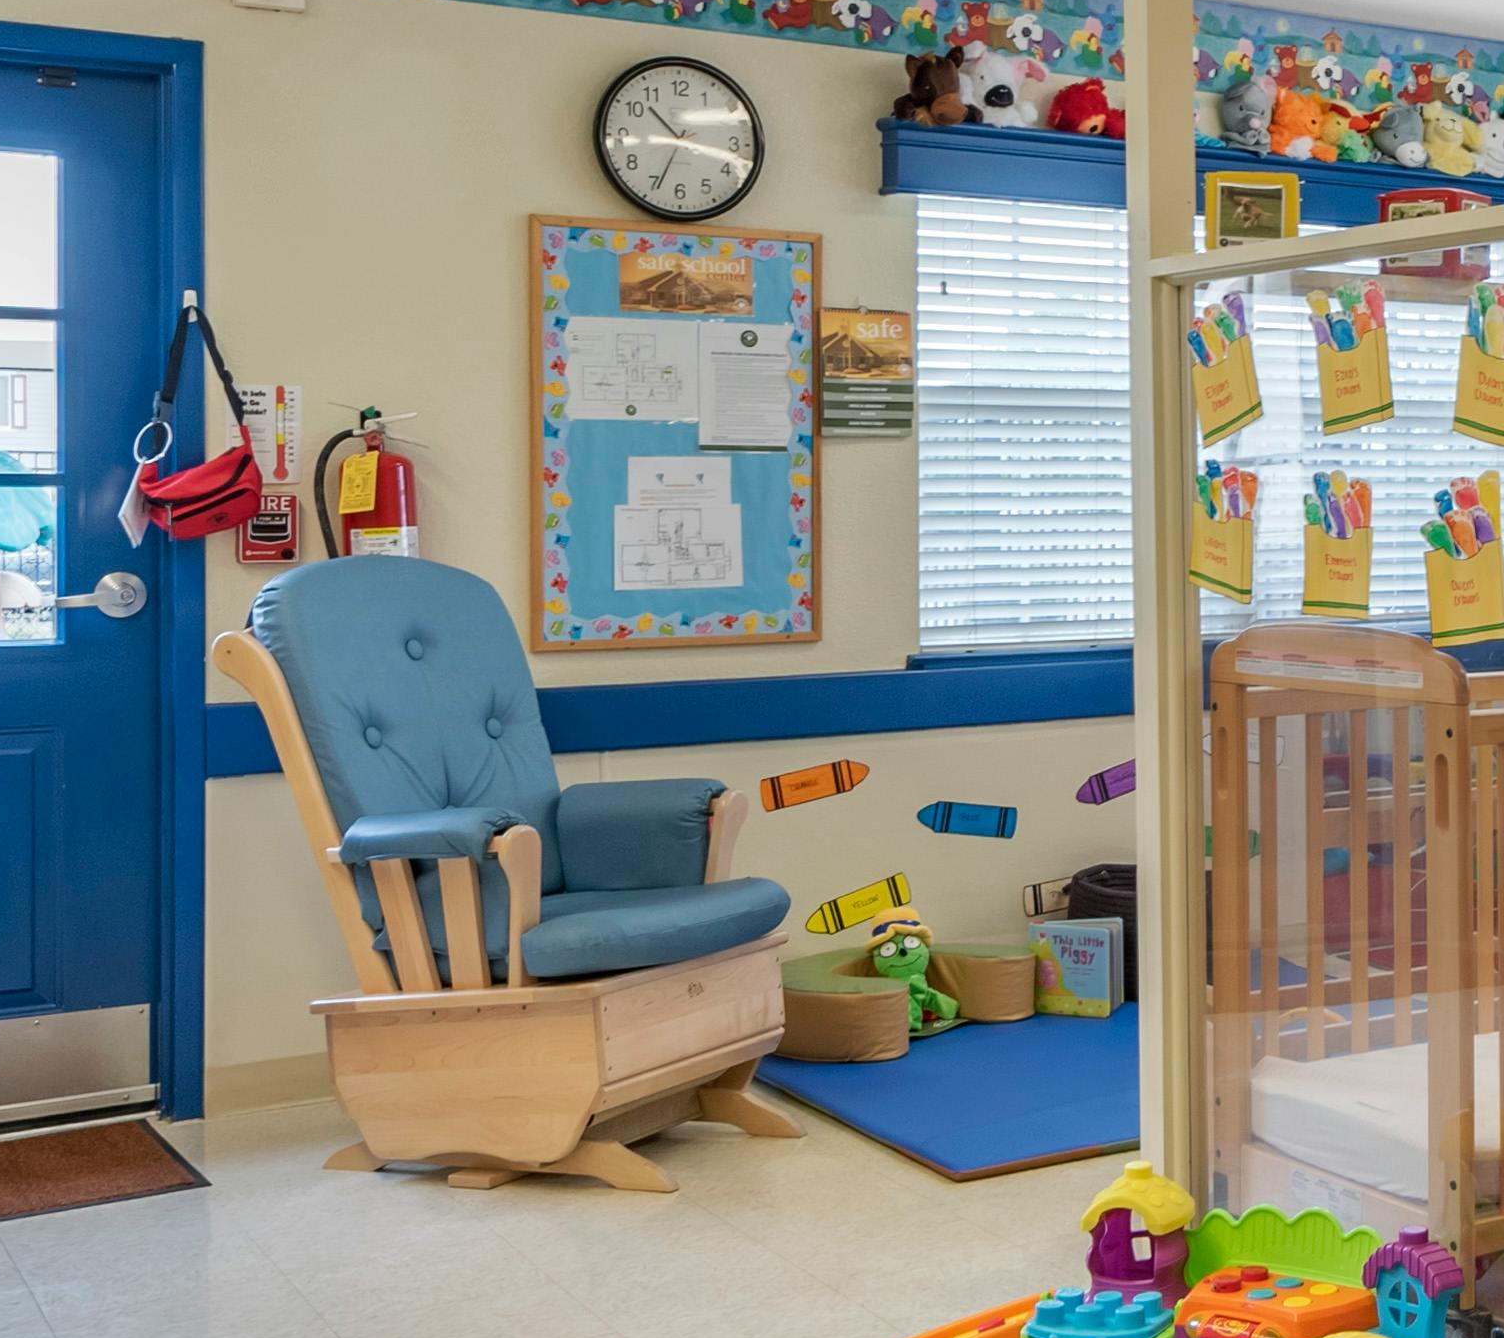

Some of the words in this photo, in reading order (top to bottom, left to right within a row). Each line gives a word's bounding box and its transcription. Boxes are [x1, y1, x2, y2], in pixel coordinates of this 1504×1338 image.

[643, 86, 659, 103] 11
[672, 80, 689, 97] 12
[701, 92, 708, 106] 1
[625, 101, 644, 117] 10
[729, 136, 739, 152] 3
[626, 154, 638, 170] 8
[721, 162, 732, 177] 4
[649, 175, 660, 191] 7
[674, 183, 686, 199] 6
[701, 179, 712, 194] 5
[637, 255, 675, 270] safe
[682, 256, 746, 274] school
[706, 271, 746, 282] center
[856, 318, 903, 339] safe
[261, 496, 292, 511] IRE
[1052, 934, 1073, 946] This
[1078, 935, 1105, 948] Little
[1060, 946, 1096, 965] Piggy
